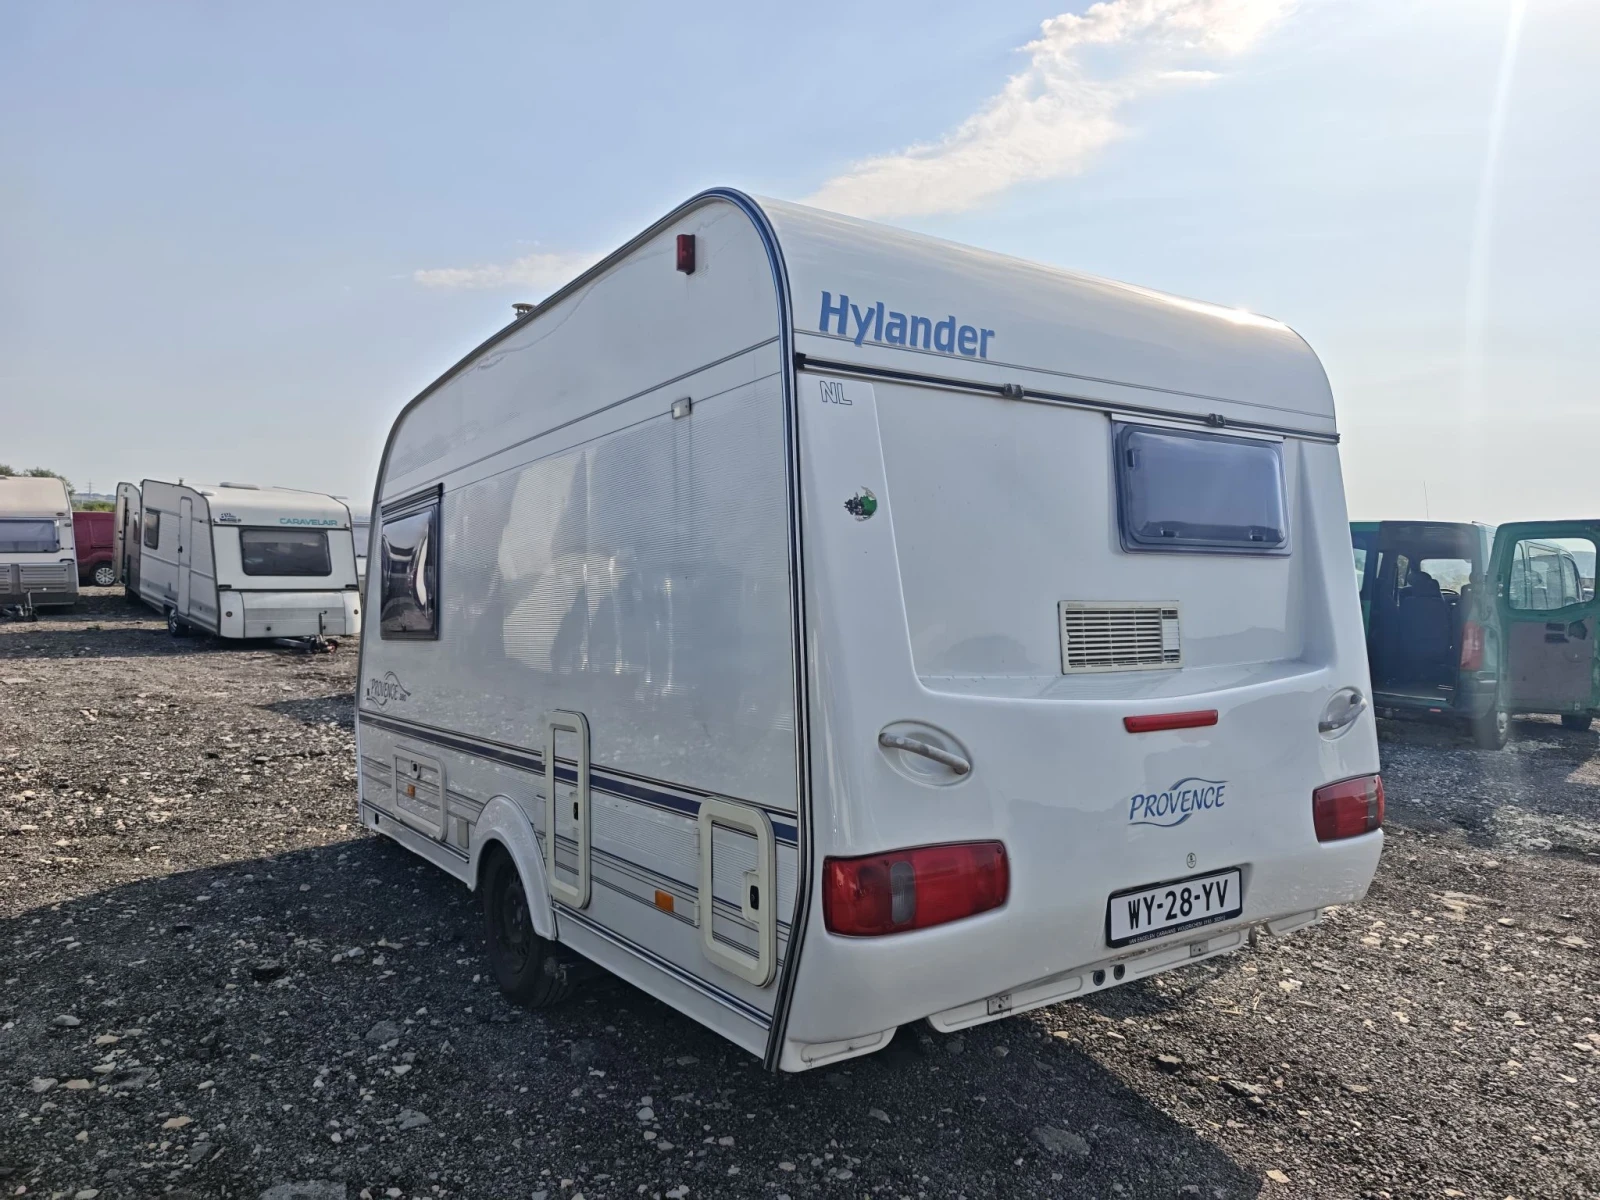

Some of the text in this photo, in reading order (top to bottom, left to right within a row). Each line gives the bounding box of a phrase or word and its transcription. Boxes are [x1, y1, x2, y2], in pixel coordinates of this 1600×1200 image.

[819, 291, 995, 359] Hylander
[820, 381, 852, 405] NL
[279, 518, 338, 526] CARAVELAIR
[371, 678, 399, 701] PROVENCE
[1129, 785, 1226, 820] PROVENCE
[1128, 879, 1228, 930] WY-28-YV
